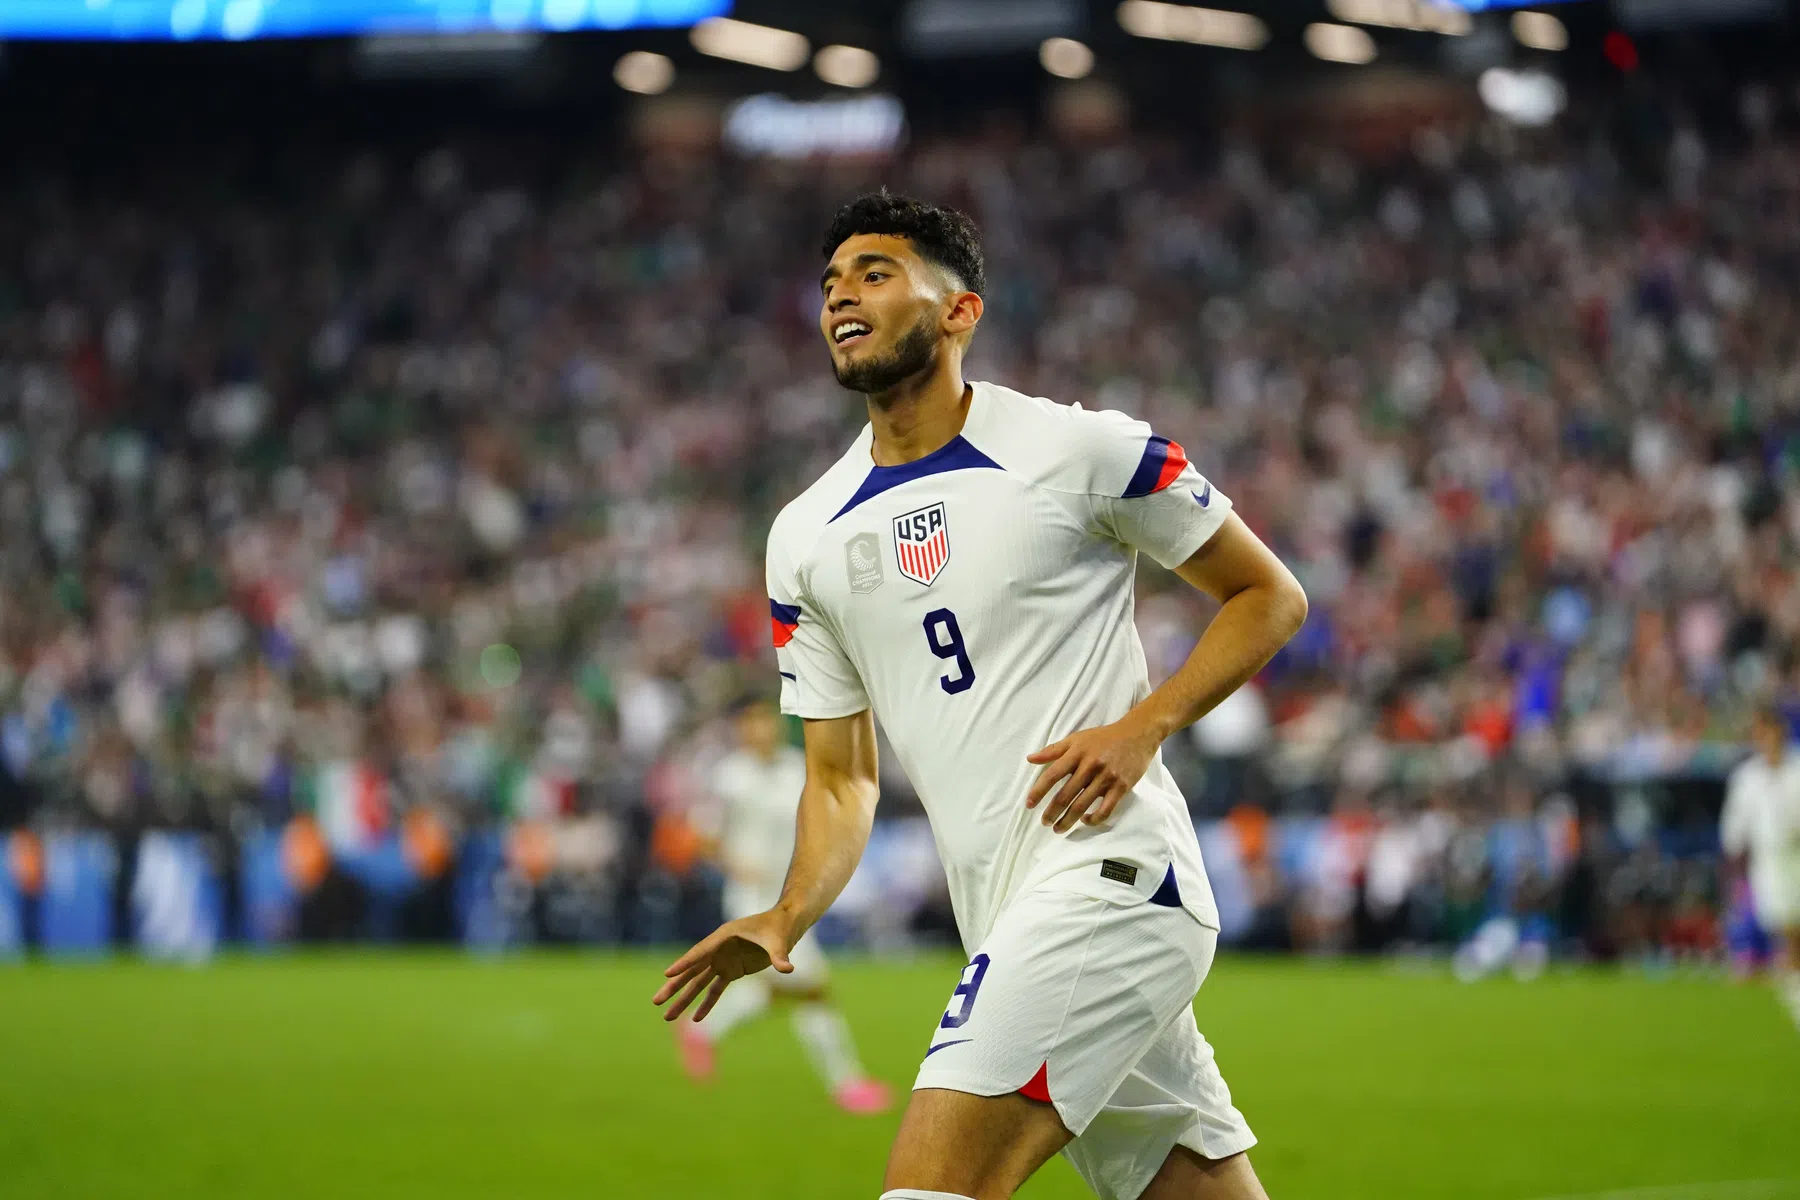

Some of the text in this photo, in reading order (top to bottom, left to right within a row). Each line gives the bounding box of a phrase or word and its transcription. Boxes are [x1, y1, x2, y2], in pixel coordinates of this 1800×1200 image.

[898, 508, 942, 542] USA
[922, 607, 976, 695] 9
[941, 953, 991, 1029] 9
